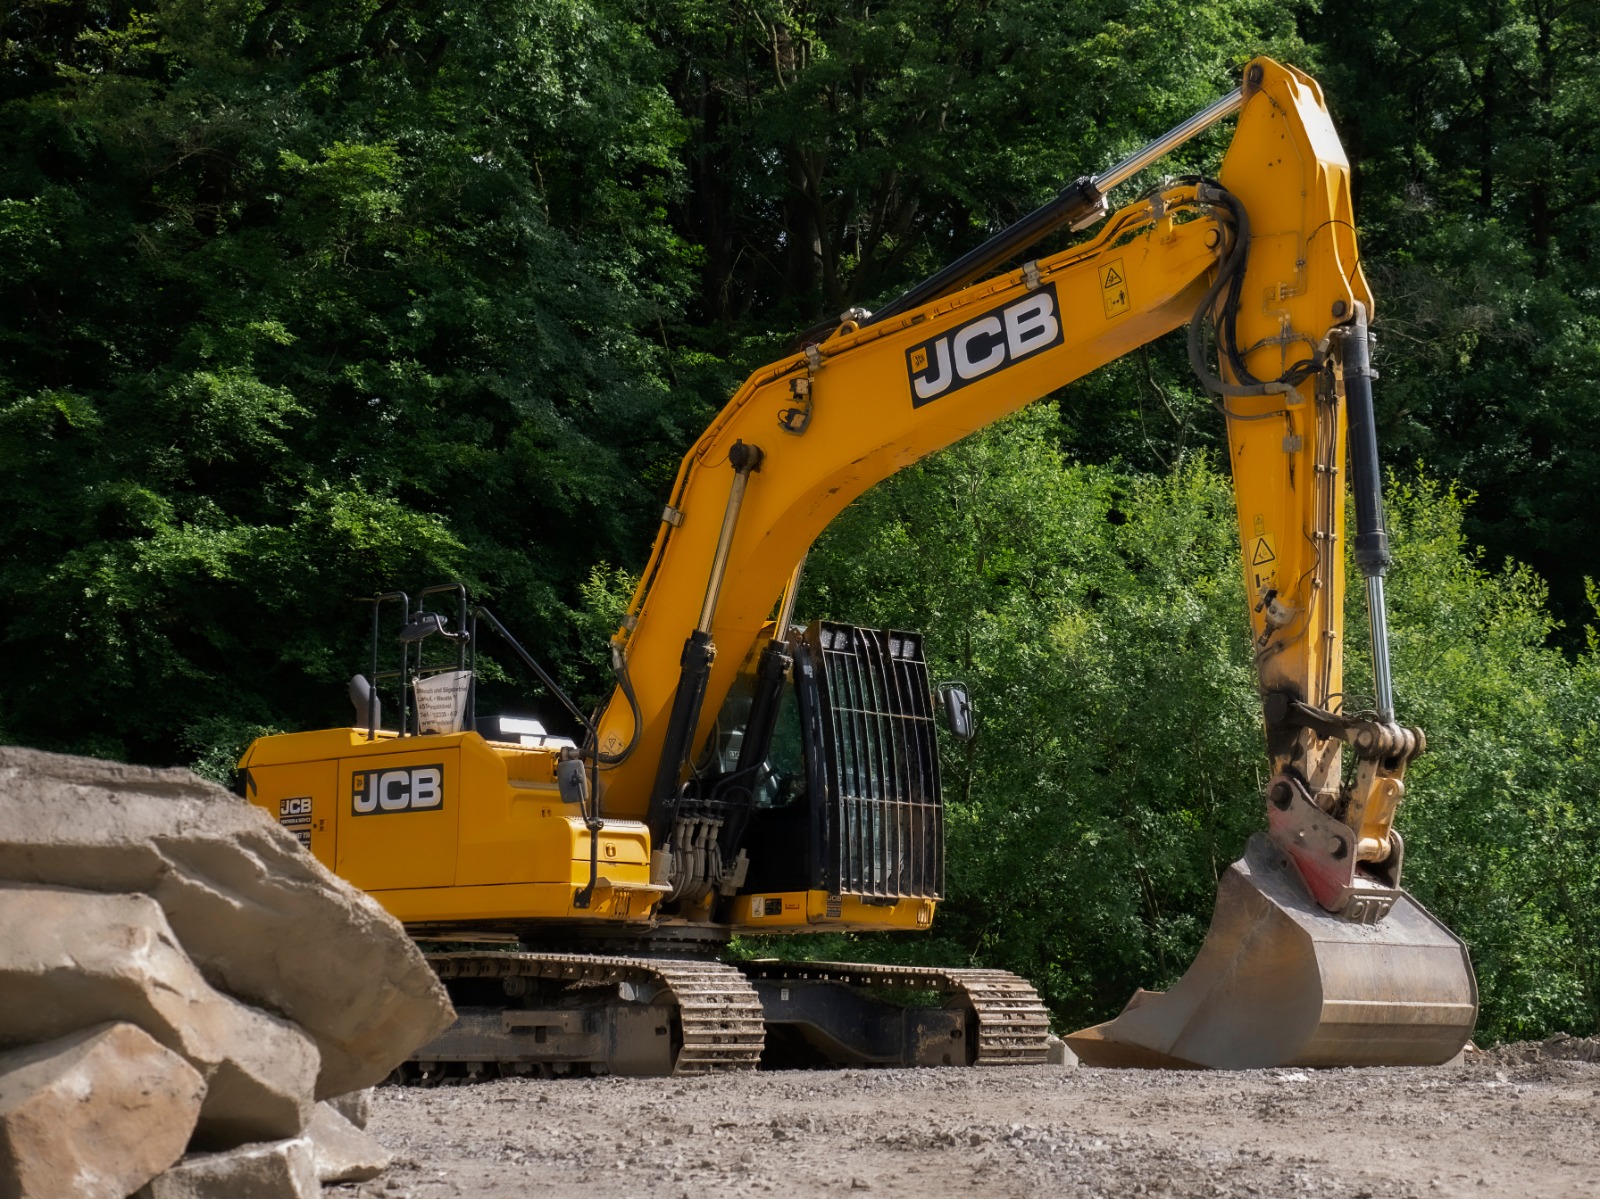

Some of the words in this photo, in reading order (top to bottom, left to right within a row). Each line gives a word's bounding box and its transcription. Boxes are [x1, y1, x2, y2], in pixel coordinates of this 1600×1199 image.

[914, 293, 1058, 399] JCB
[281, 798, 312, 815] JCB
[354, 768, 442, 813] JCB
